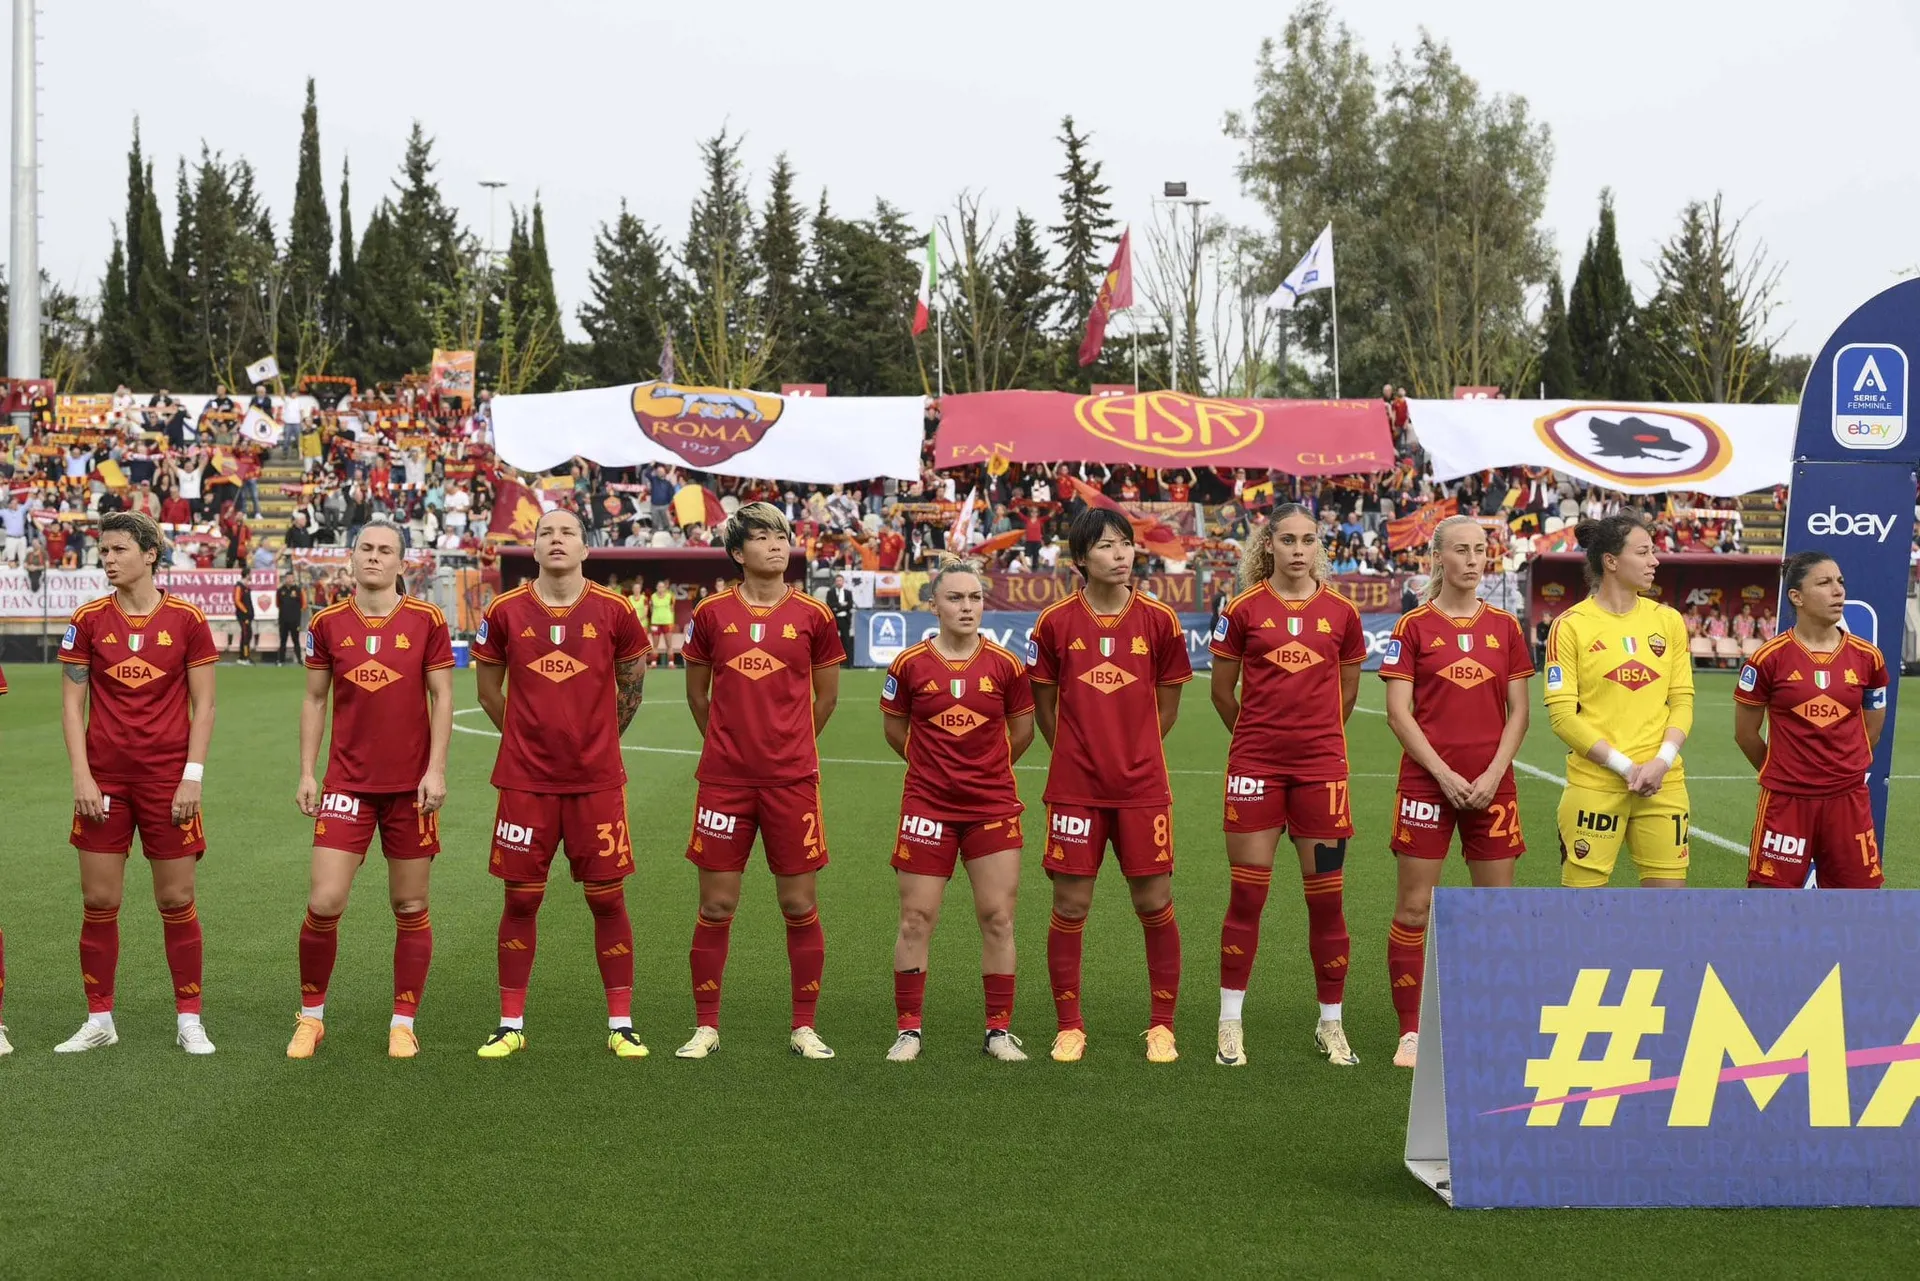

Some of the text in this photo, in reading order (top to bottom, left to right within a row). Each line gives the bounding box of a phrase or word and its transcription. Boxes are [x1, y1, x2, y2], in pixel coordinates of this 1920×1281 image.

[1847, 402, 1892, 410] FEMMINILE
[1853, 394, 1887, 402] SERIE A
[1091, 392, 1247, 446] ASR
[1847, 420, 1891, 438] ebay
[651, 421, 754, 443] ROMA
[680, 440, 721, 457] 1927
[1807, 505, 1898, 543] ebay
[3, 595, 32, 609] FAN
[540, 660, 576, 674] IBSA
[738, 656, 774, 671] IBSA
[1276, 651, 1312, 664] IBSA
[116, 666, 153, 679] IBSA
[354, 669, 389, 683] IBSA
[1090, 671, 1125, 684] IBSA
[1449, 666, 1485, 680] IBSA
[1616, 668, 1652, 682] IBSA
[940, 714, 977, 727] IBSA
[1804, 704, 1840, 718] IBSA
[1227, 775, 1265, 795] HDI
[320, 793, 361, 816] HDI
[1326, 780, 1347, 815] 17
[697, 806, 737, 834] HDI
[1400, 798, 1441, 822] HDI
[1488, 800, 1520, 838] 22
[1576, 809, 1619, 832] HDI
[496, 818, 534, 846] HDI
[801, 812, 818, 847] 2
[901, 814, 943, 840] HDI
[1052, 813, 1091, 837] HDI
[1153, 814, 1168, 847] 8
[596, 820, 629, 857] 32
[1762, 830, 1807, 857] HDI
[1855, 828, 1879, 867] 13
